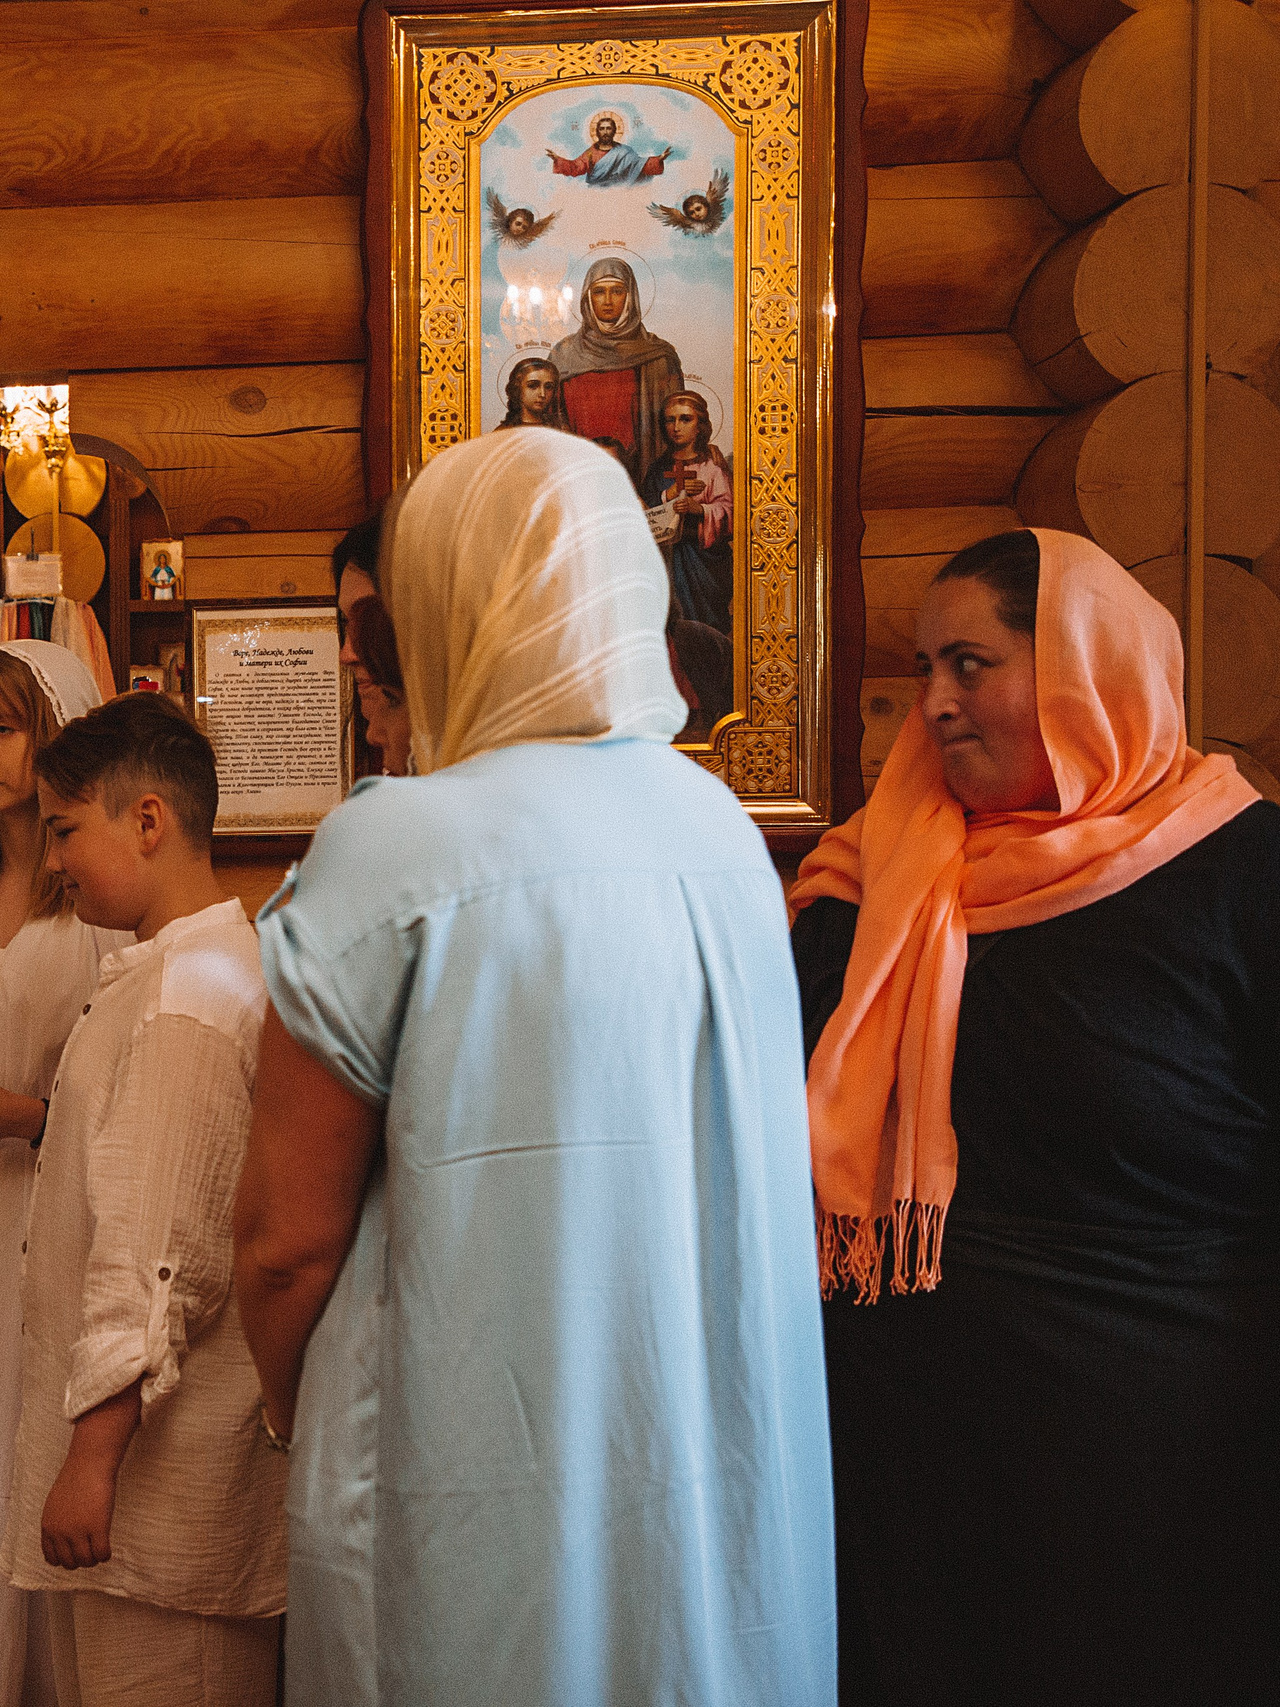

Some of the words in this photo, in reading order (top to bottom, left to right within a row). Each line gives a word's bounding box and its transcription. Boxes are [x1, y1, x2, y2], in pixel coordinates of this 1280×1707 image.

[285, 647, 314, 656] Любови
[245, 660, 273, 668] матери
[274, 661, 282, 669] их
[284, 659, 308, 669] Софии
